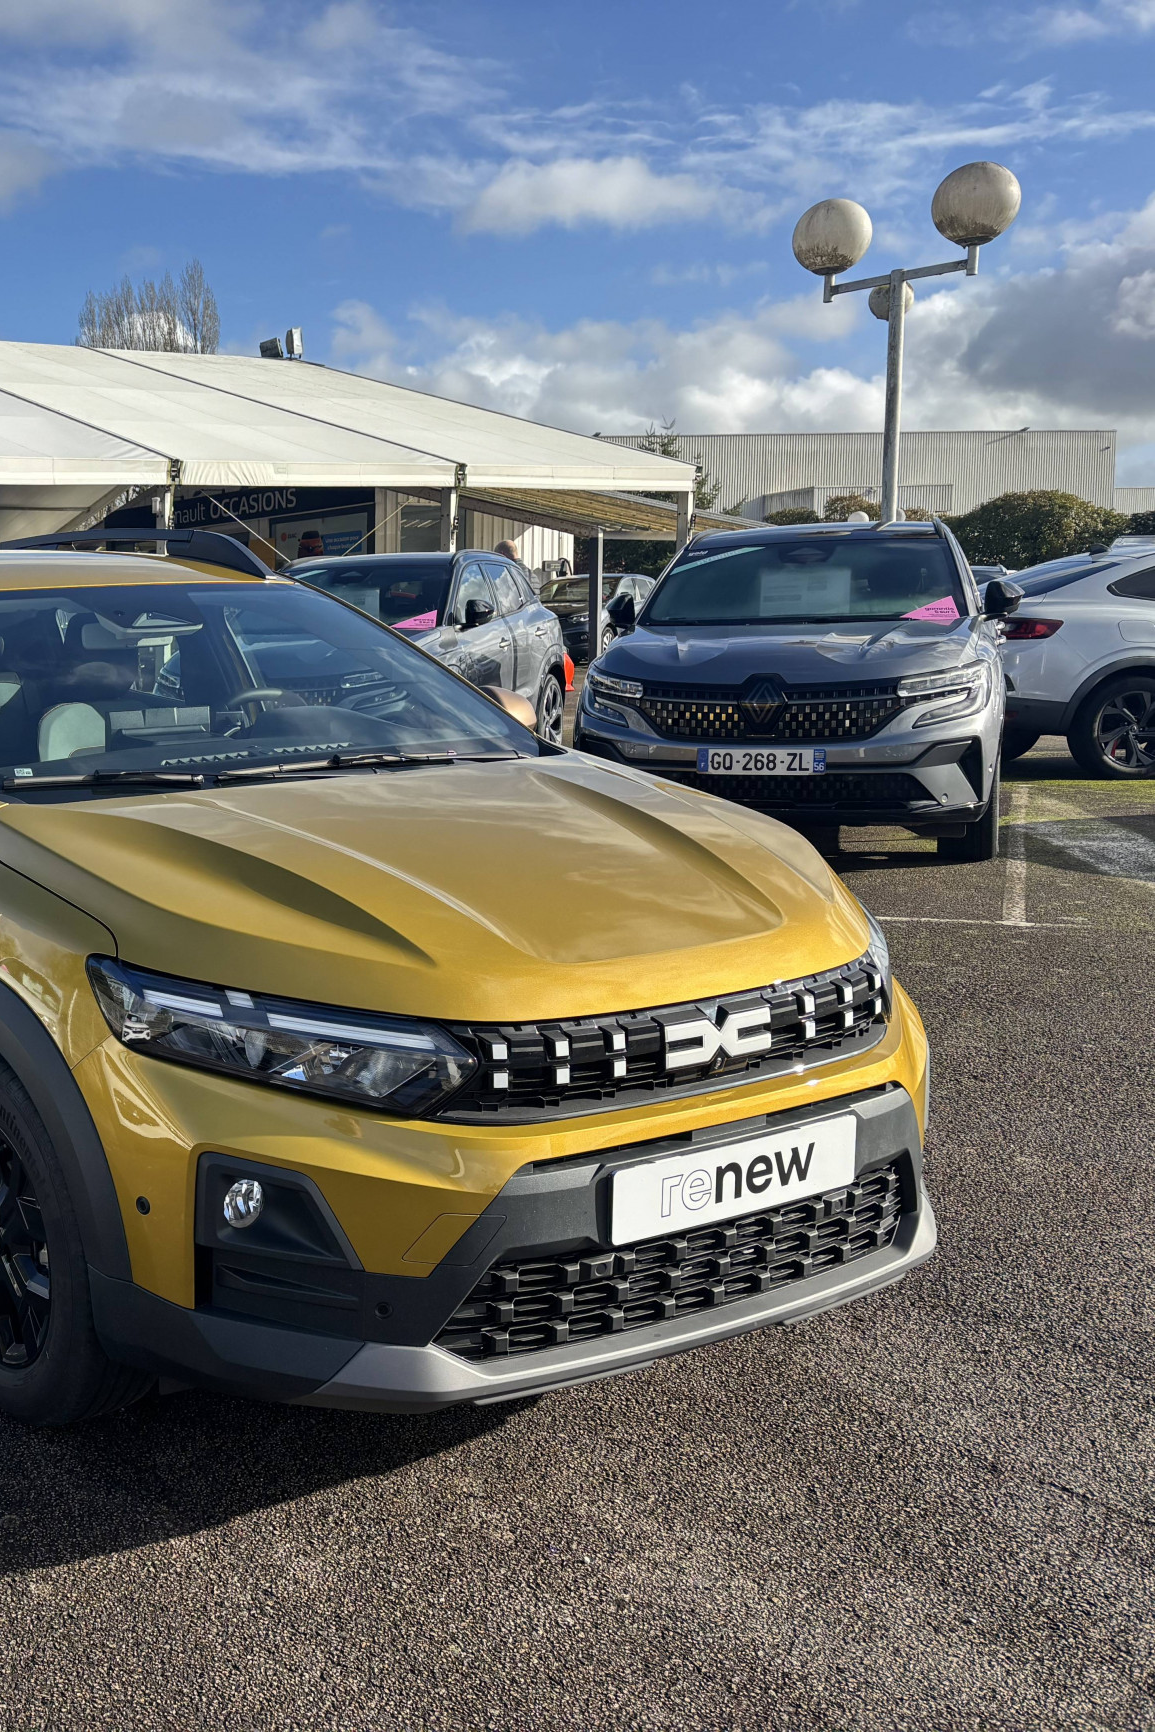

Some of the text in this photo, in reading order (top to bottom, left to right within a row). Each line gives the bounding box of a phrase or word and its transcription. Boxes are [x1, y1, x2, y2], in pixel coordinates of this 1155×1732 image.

[174, 488, 297, 524] nault OCCASIONS
[710, 752, 810, 772] GQ-268-ZL
[813, 762, 825, 771] 56
[661, 1142, 816, 1218] renew
